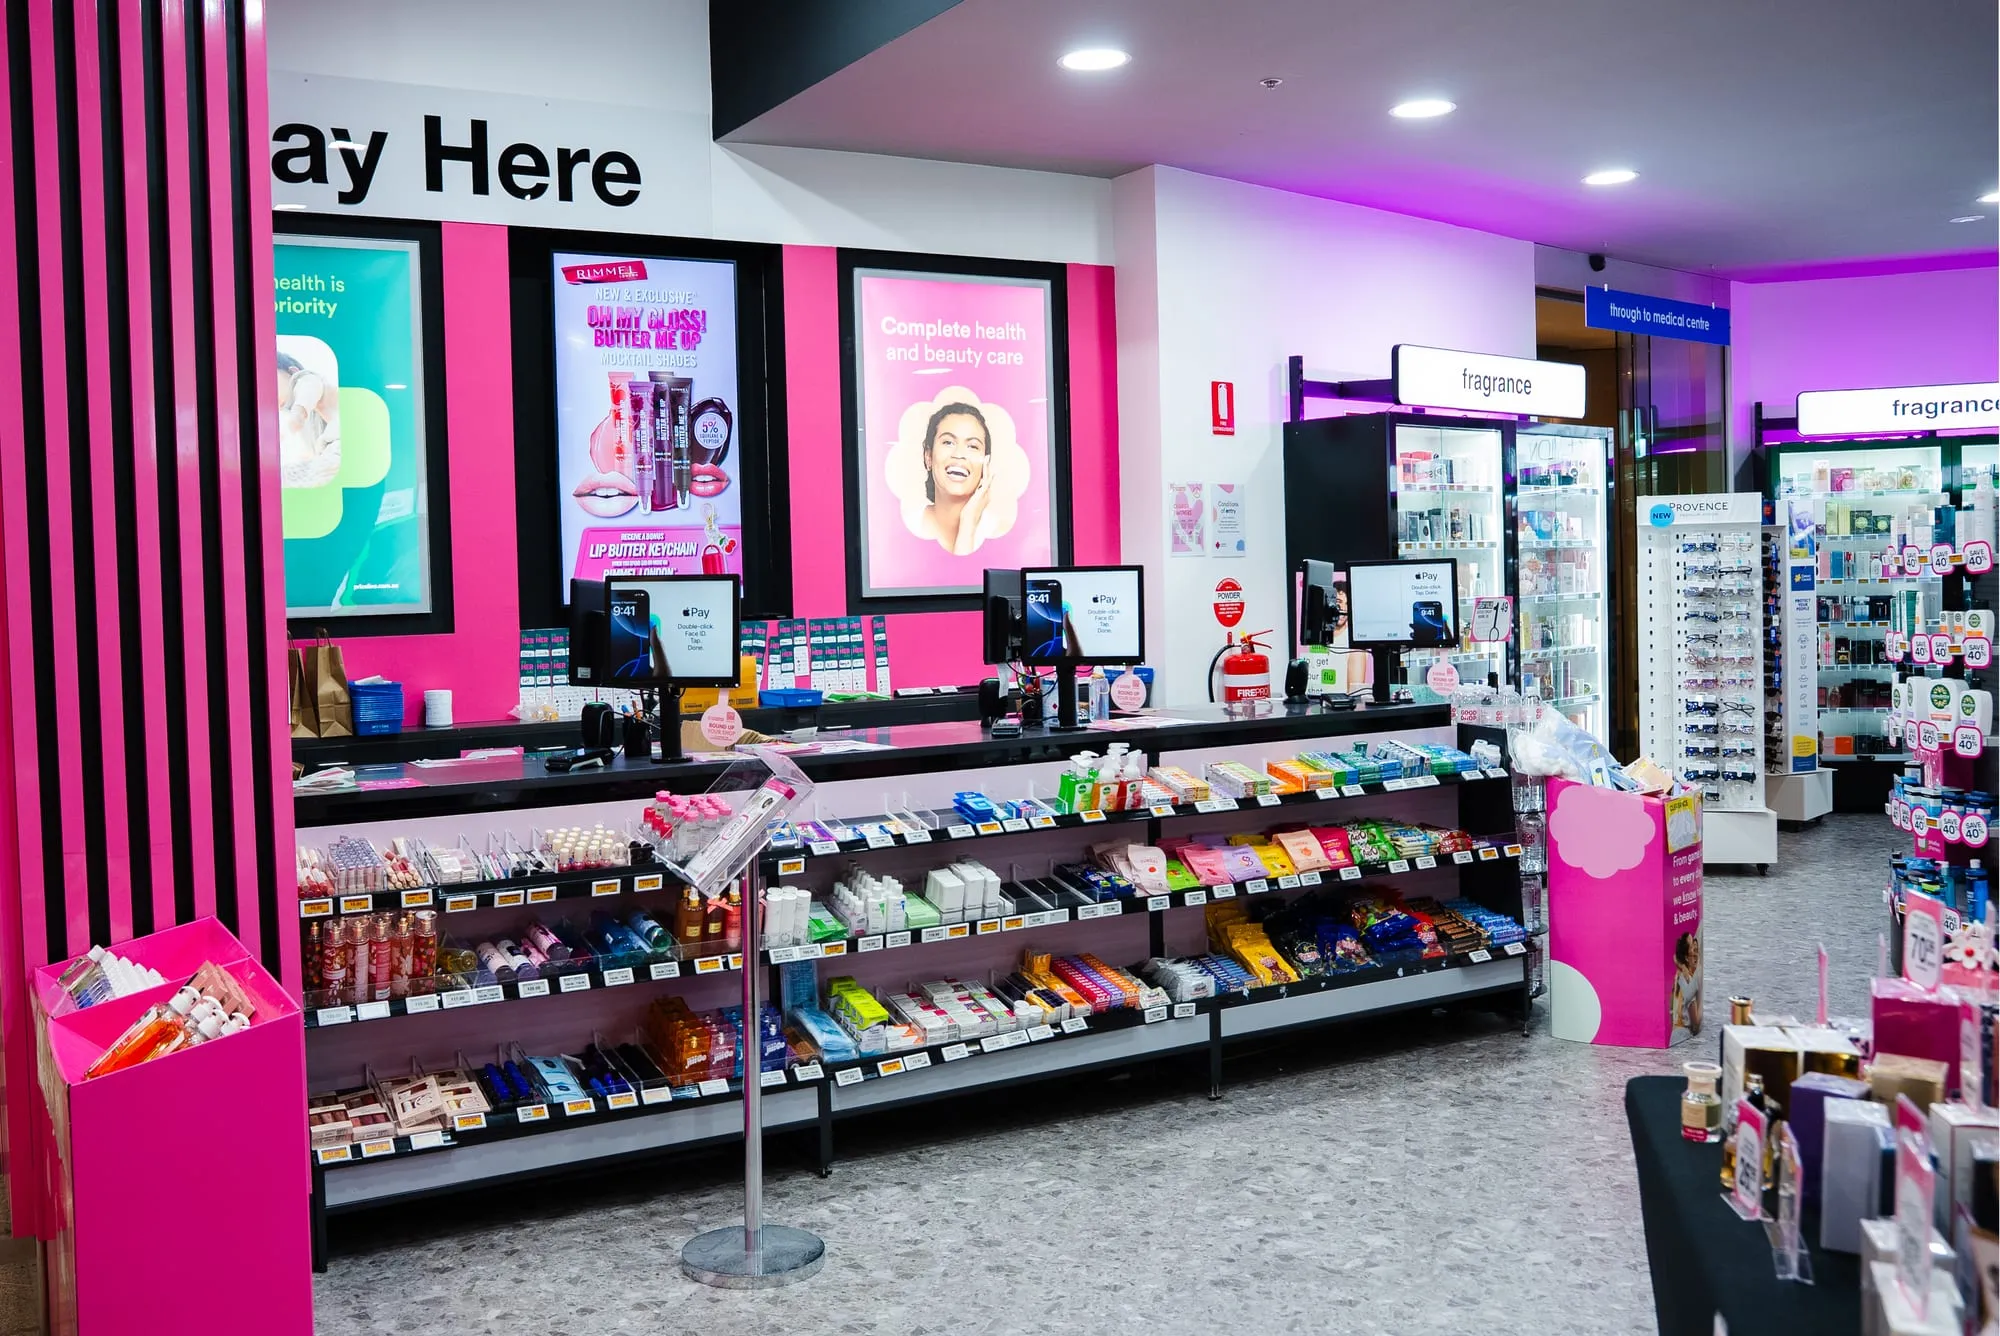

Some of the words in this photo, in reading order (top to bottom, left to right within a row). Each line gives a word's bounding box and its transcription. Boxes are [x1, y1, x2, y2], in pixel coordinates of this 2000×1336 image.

[272, 122, 388, 205] ay
[424, 114, 641, 207] Here
[576, 265, 633, 279] RIMMEL
[331, 275, 345, 293] is
[595, 288, 621, 301] NEW
[625, 289, 632, 301] &
[587, 305, 612, 328] OH
[616, 306, 644, 328] MY
[647, 308, 707, 333] GLOSS!
[1610, 303, 1642, 324] through
[1643, 308, 1651, 321] to
[1653, 309, 1685, 328] medical
[1686, 314, 1710, 331] centre
[880, 316, 971, 340] Complete
[975, 320, 1026, 341] health
[594, 329, 651, 349] BUTTER
[654, 331, 677, 350] ME
[681, 332, 702, 351] UP
[600, 352, 653, 367] MOCKTAIL
[655, 354, 698, 368] SHADES
[886, 343, 919, 361] and
[924, 344, 983, 368] beauty
[987, 350, 1024, 365] care
[1462, 367, 1533, 398] fragrance
[702, 421, 719, 434] 5%
[1669, 502, 1729, 511] PROVENCE
[1652, 512, 1672, 520] NEW
[589, 543, 607, 558] LIP
[608, 542, 648, 558] BUTTER
[648, 541, 699, 557] KEYCHAIN
[1969, 548, 1984, 556] SAVE
[1906, 558, 1916, 567] 40
[1935, 557, 1947, 567] 40
[1969, 555, 1987, 565] 40%
[1422, 572, 1438, 581] Pay
[1027, 593, 1049, 604] 9:41
[1100, 594, 1117, 605] Pay
[612, 605, 635, 617] 9:41
[1501, 601, 1508, 612] 49
[691, 607, 710, 619] Pay
[677, 623, 714, 631] Double-click.
[1935, 648, 1947, 657] 40
[1967, 651, 1986, 660] 40%
[1316, 659, 1328, 667] get
[1324, 672, 1333, 680] flu
[1923, 728, 1935, 736] SAVE
[1958, 740, 1978, 750] 40%
[1914, 820, 1924, 830] 40
[1943, 817, 1958, 825] SAVE
[1965, 828, 1984, 838] 40%
[1673, 855, 1687, 868] From
[1673, 876, 1679, 887] to
[1679, 872, 1696, 885] every
[1673, 896, 1682, 906] we
[1682, 890, 1697, 903] know
[1673, 912, 1678, 925] &
